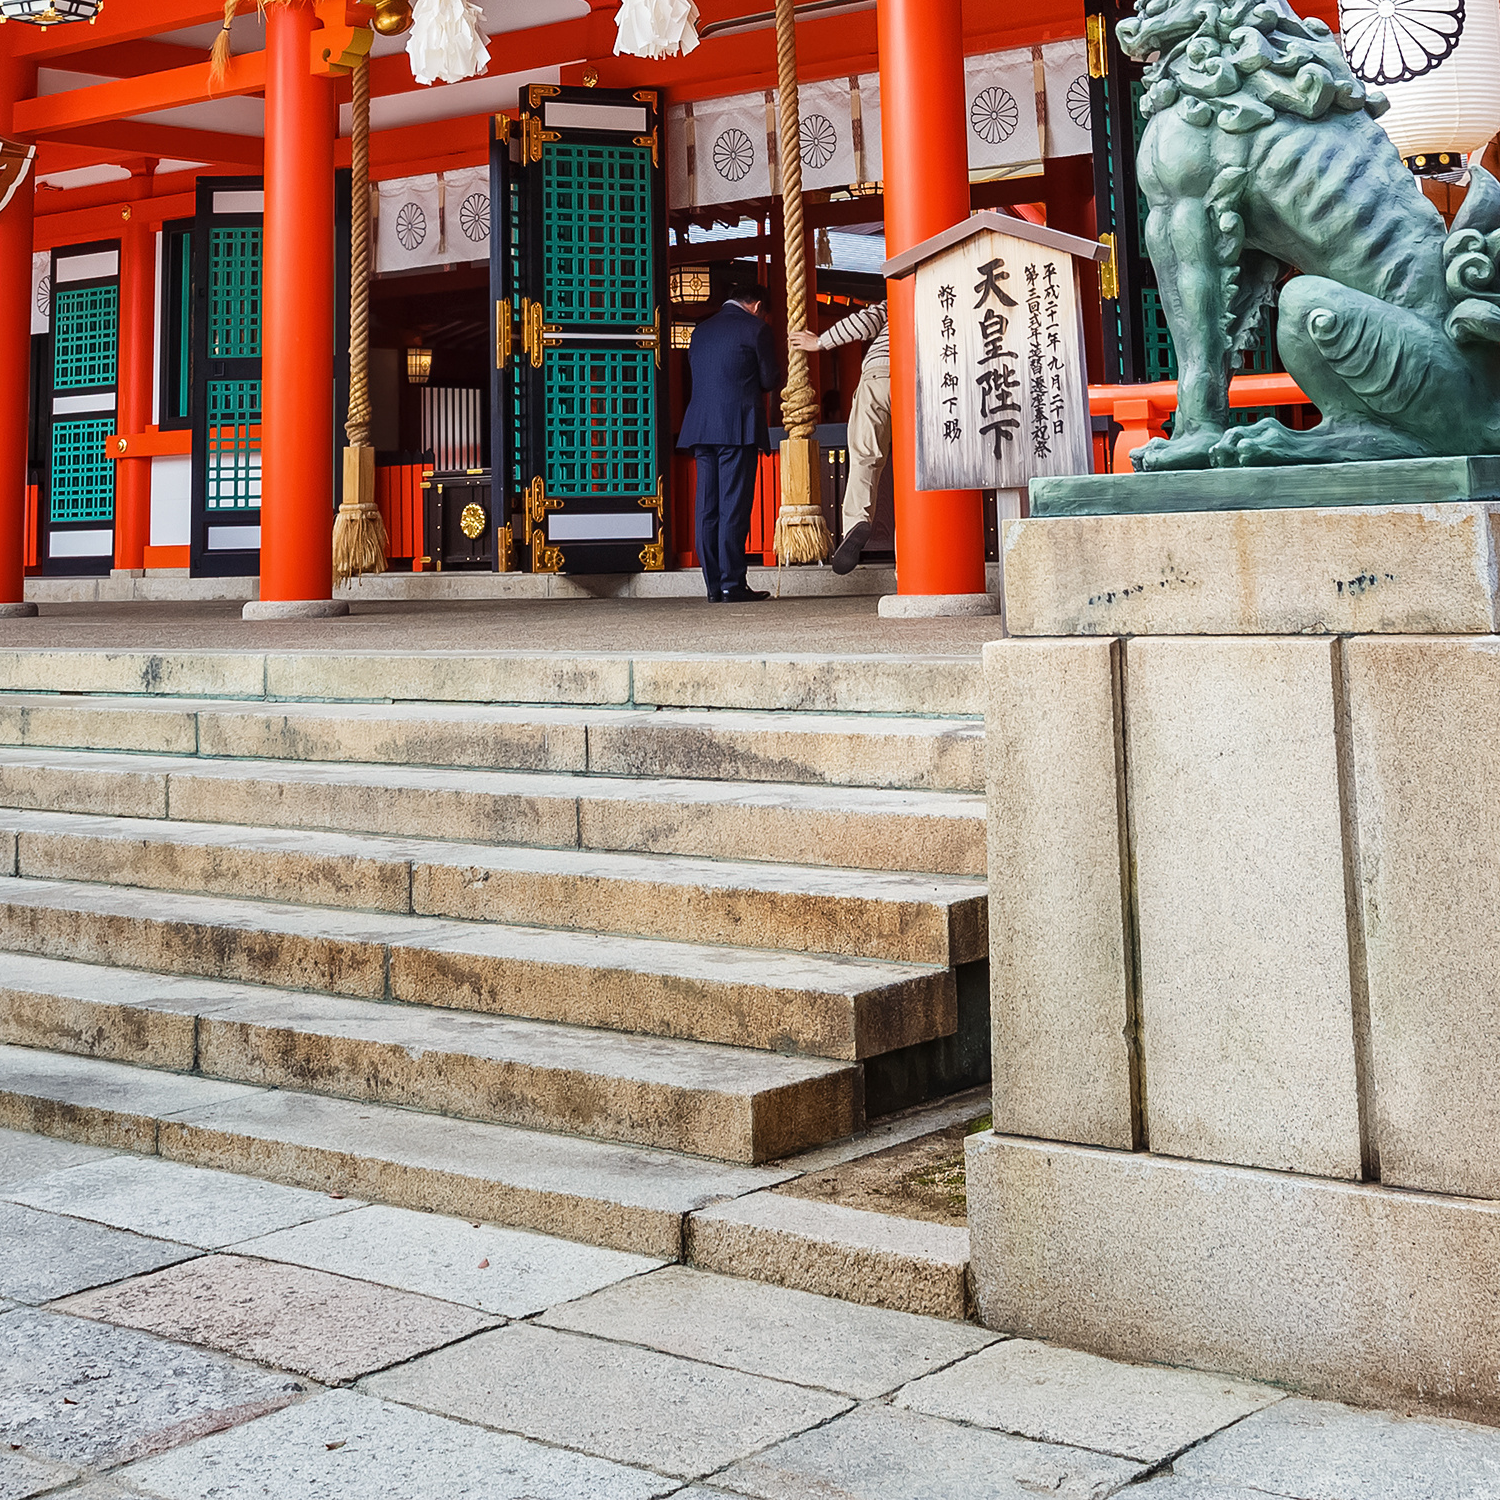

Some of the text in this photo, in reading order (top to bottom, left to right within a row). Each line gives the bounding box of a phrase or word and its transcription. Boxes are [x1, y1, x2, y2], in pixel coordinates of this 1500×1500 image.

[973, 257, 1022, 460] 天皇陛下
[1042, 262, 1064, 434] 平成二十一年九月二十日
